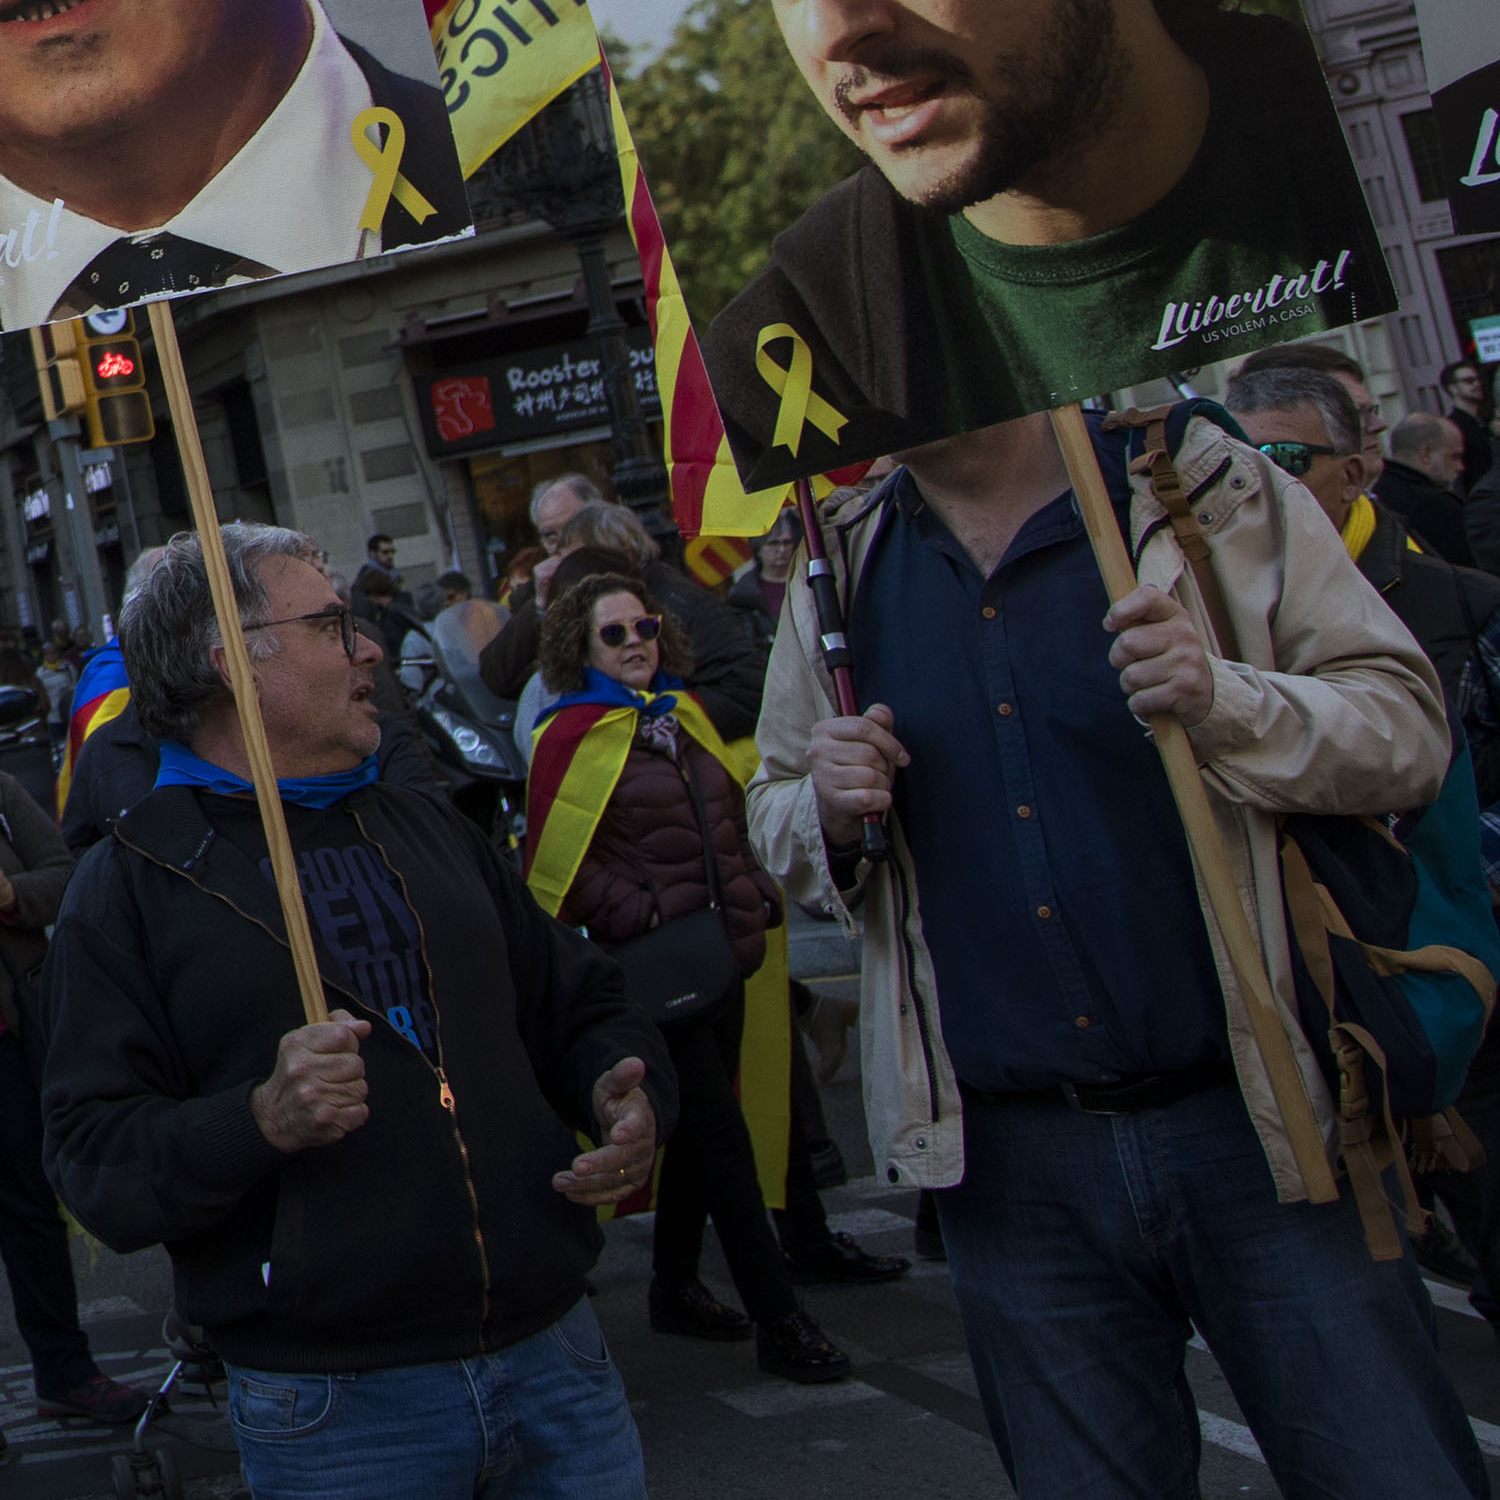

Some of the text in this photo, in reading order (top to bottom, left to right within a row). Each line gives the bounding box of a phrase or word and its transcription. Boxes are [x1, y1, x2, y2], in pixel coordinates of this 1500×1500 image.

[1150, 249, 1352, 350] Llibertat!
[1201, 302, 1318, 344] US VOLEM A CASA!
[506, 353, 600, 392] Rooster
